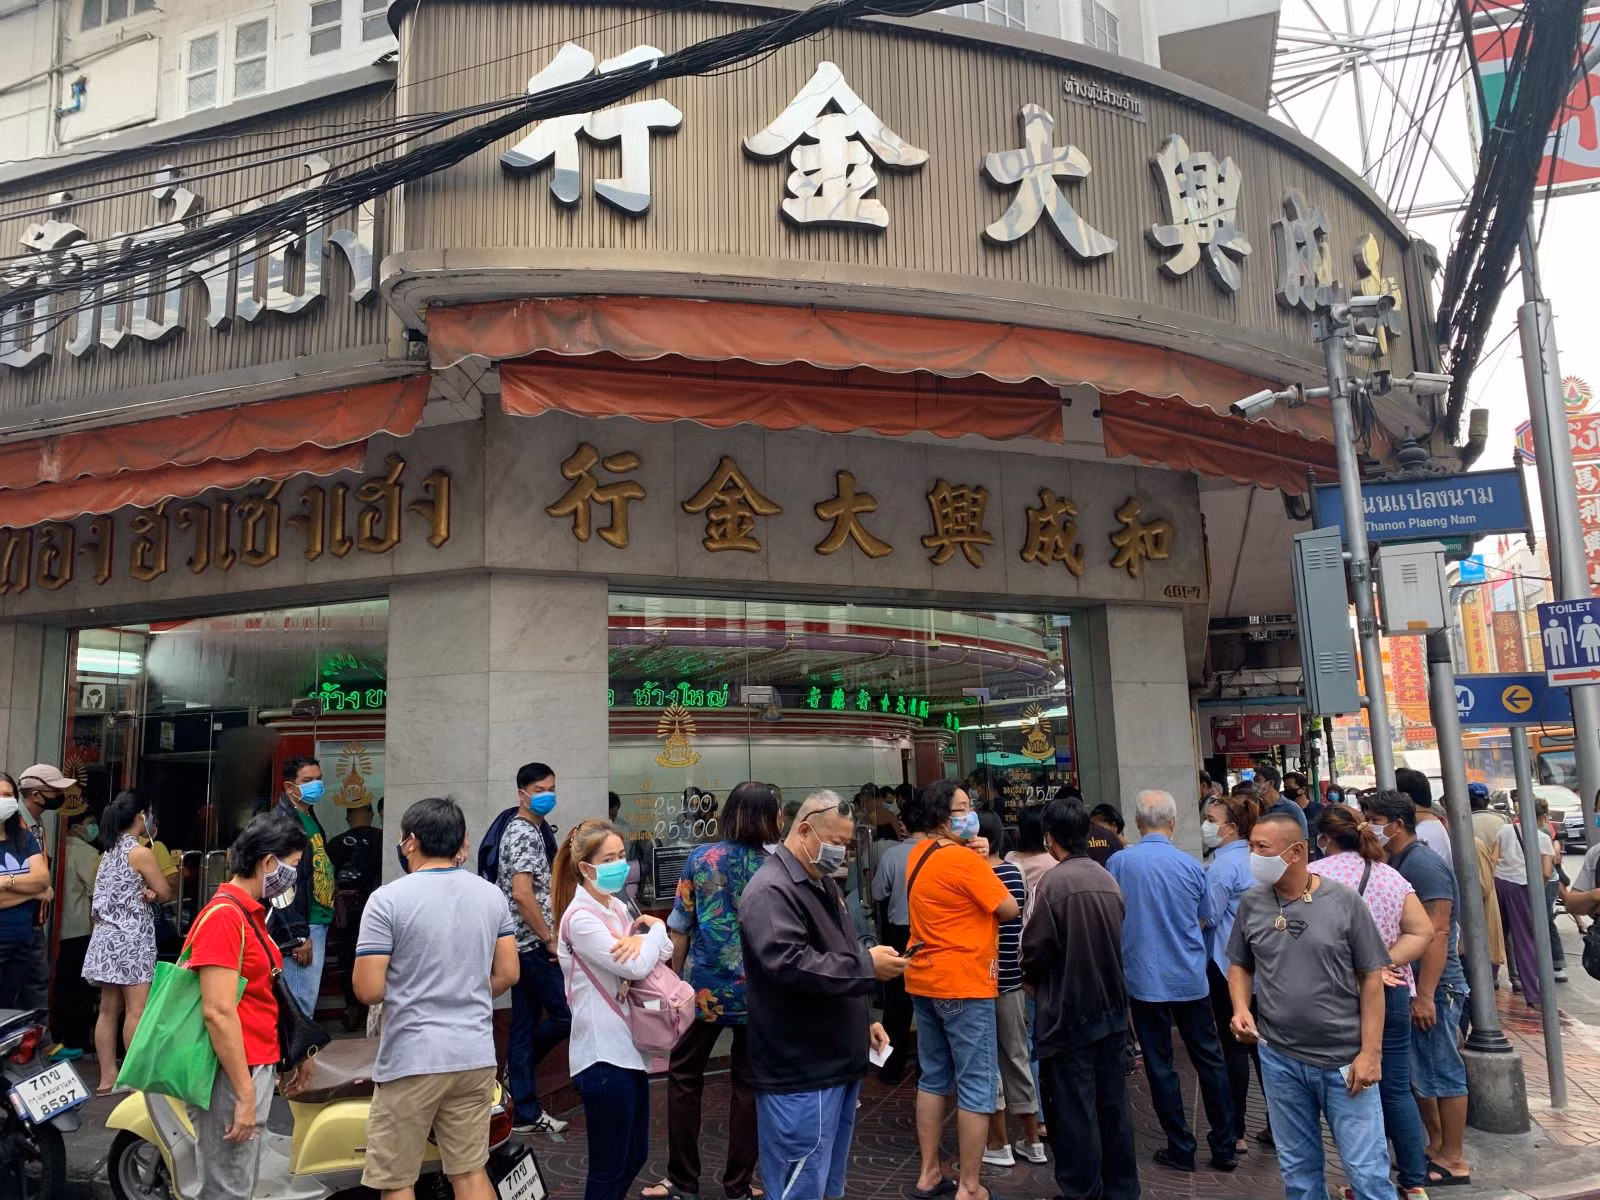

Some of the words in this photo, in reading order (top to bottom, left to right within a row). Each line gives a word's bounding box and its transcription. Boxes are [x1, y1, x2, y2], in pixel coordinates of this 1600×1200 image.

[1360, 486, 1494, 514] นนแปลงนาม
[1365, 521, 1406, 532] Thanon
[1408, 517, 1448, 529] Plaeng
[1450, 514, 1477, 525] Nam
[1548, 602, 1592, 615] TOILET
[654, 794, 713, 816] 26100
[654, 818, 718, 840] 25900
[28, 1069, 61, 1091] 7กข
[40, 1089, 76, 1115] 8597
[505, 1161, 528, 1191] 7กข
